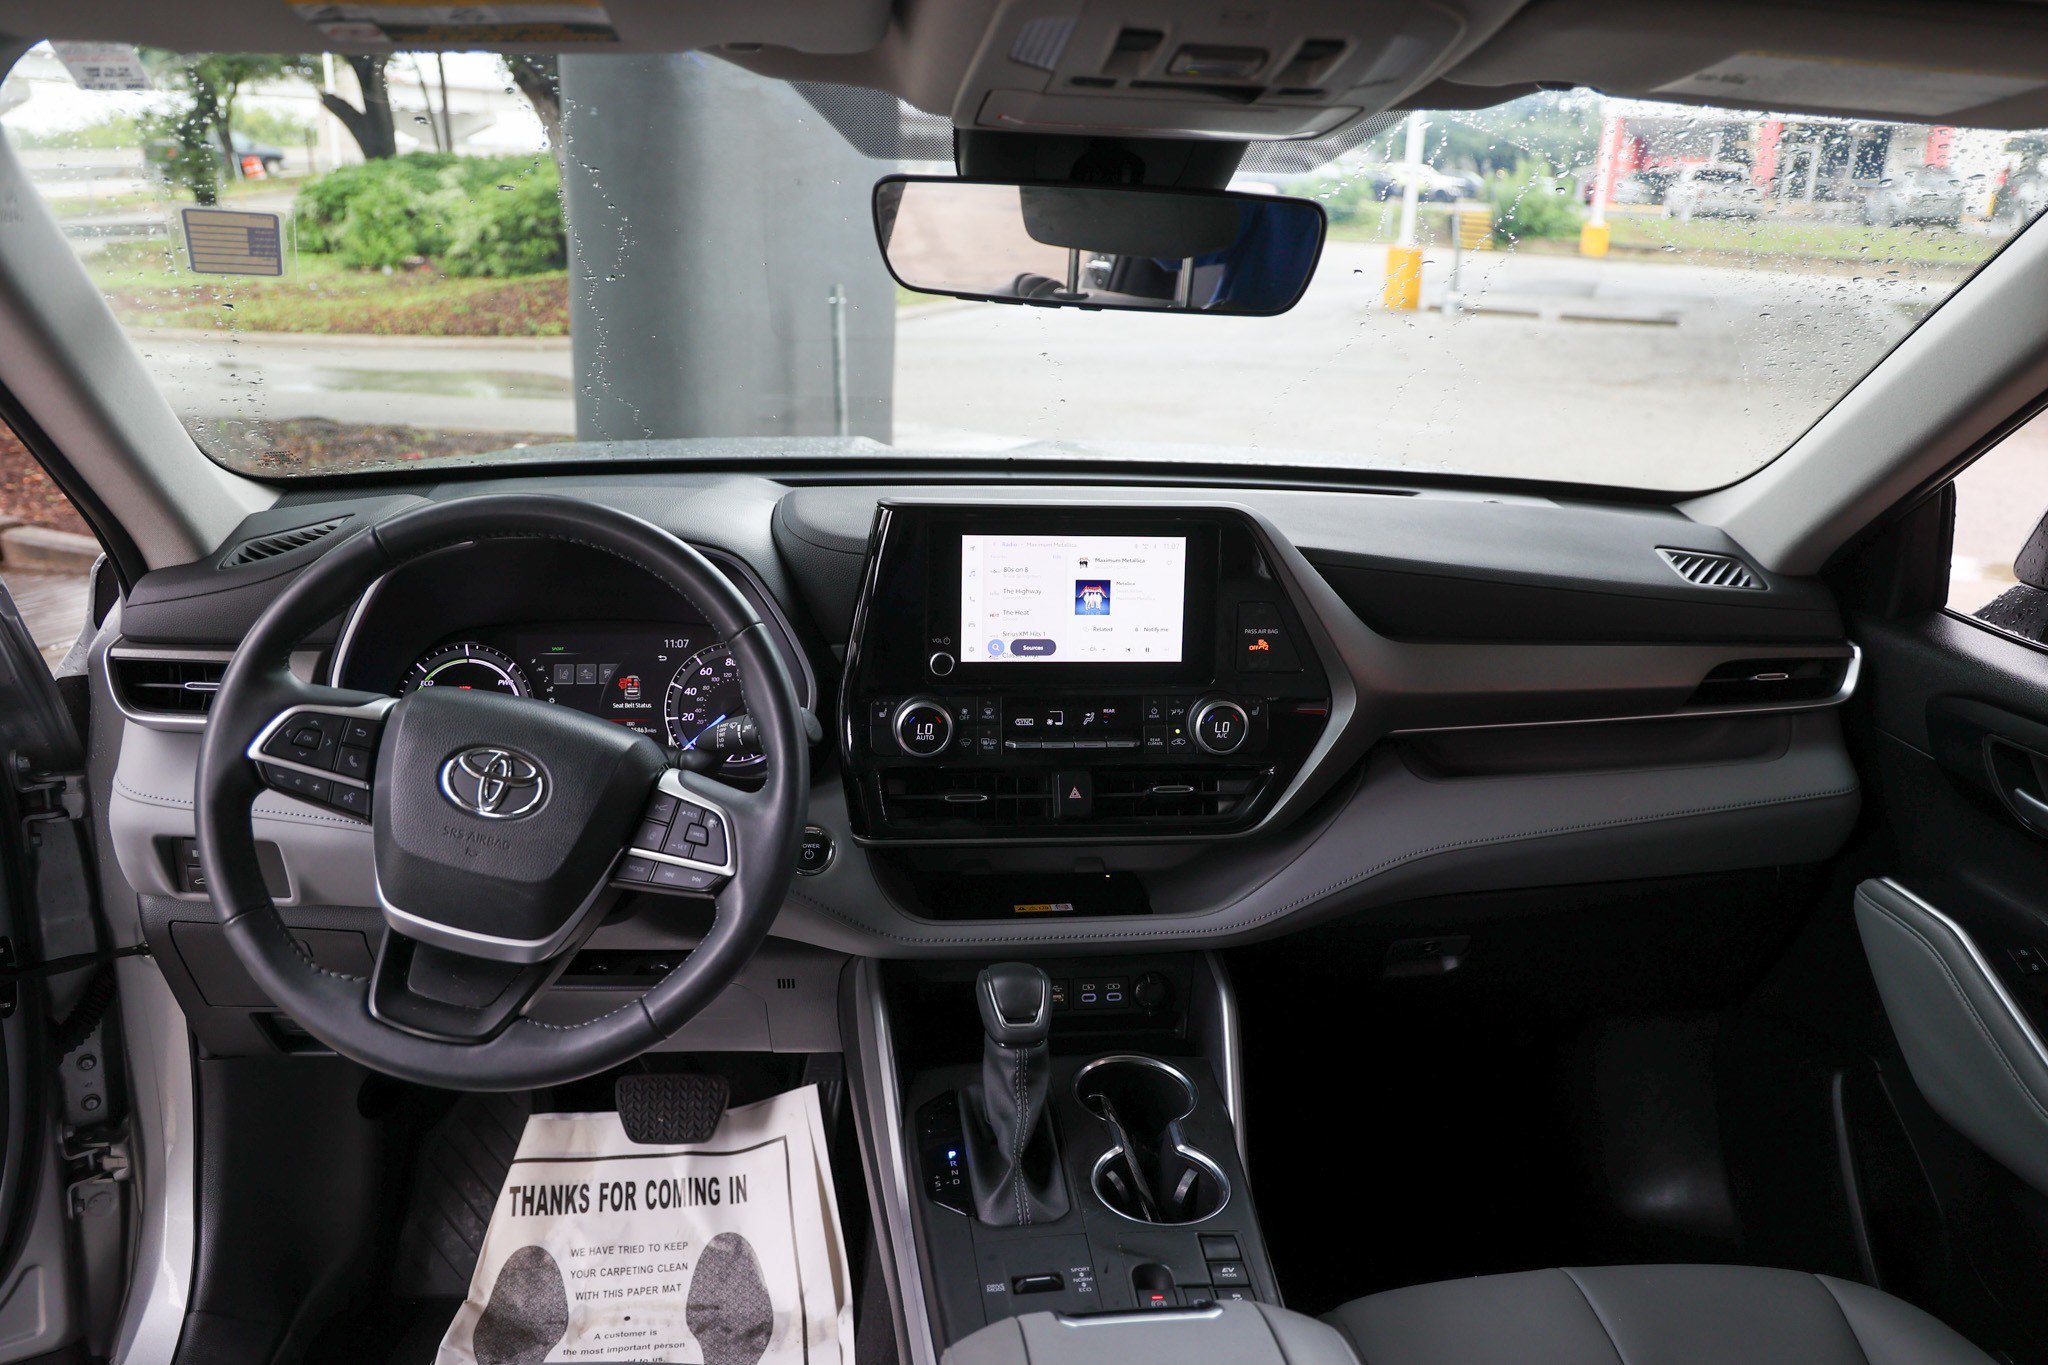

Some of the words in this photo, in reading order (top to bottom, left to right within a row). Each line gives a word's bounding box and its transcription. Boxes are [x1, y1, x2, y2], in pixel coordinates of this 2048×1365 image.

[664, 639, 689, 648] 11:07
[684, 687, 697, 696] 40
[682, 713, 694, 721] 20
[443, 825, 464, 839] SRS
[948, 1151, 956, 1159] P
[510, 1184, 590, 1217] THANKS
[598, 1180, 636, 1212] FOR
[645, 1176, 720, 1210] COMING
[729, 1174, 748, 1205] IN
[570, 1248, 585, 1258] WE
[589, 1246, 614, 1256] HAVE
[618, 1244, 645, 1254] TRIED
[649, 1244, 660, 1252] TO
[664, 1242, 688, 1252] KEEP
[570, 1269, 596, 1279] YOUR
[600, 1265, 653, 1277] CARPETING
[657, 1262, 688, 1273] CLEAN
[575, 1291, 599, 1300] WITH
[604, 1289, 623, 1299] THIS
[627, 1286, 658, 1296] PAPER
[662, 1284, 682, 1293] MAT
[607, 1344, 651, 1353] important
[654, 1342, 685, 1350] person
